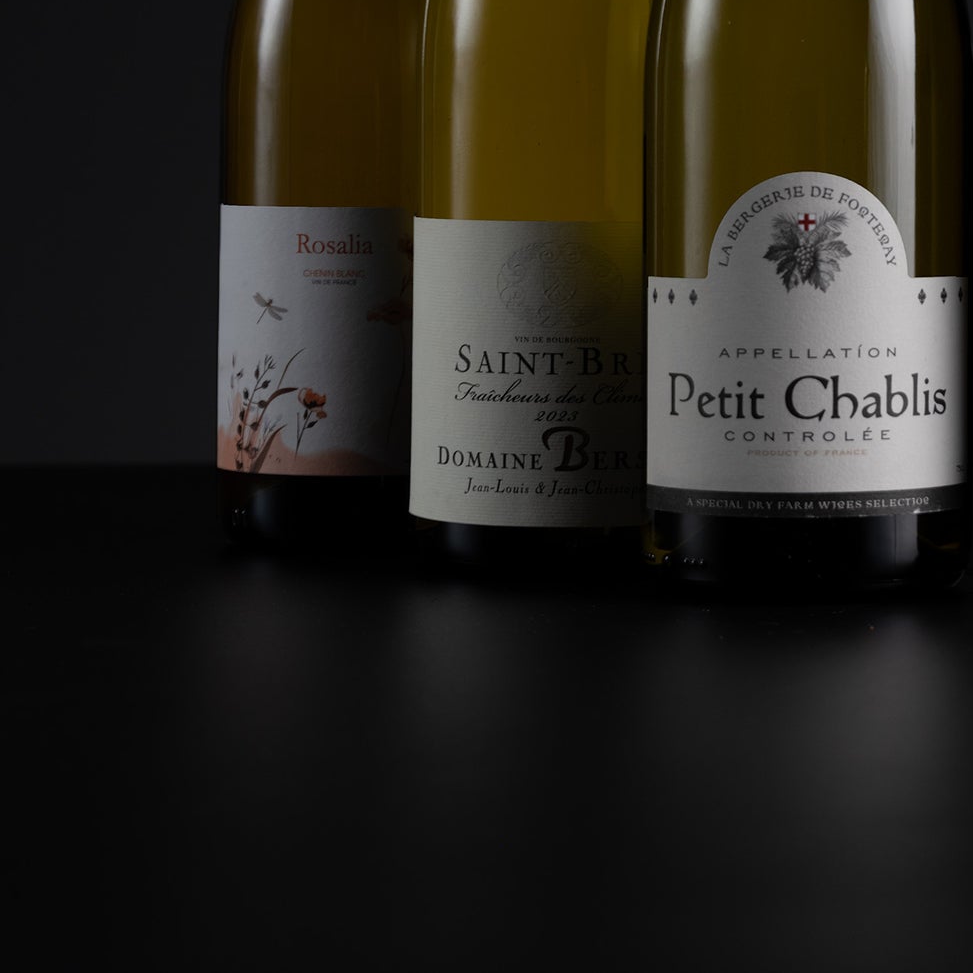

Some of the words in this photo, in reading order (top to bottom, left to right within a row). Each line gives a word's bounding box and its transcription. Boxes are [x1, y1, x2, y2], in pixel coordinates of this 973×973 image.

[718, 245, 734, 268] LA
[810, 185, 835, 200] DE
[295, 233, 374, 255] Rosalia
[514, 335, 531, 344] VIN
[532, 335, 544, 344] DE
[454, 379, 551, 404] Fraîcheurs
[555, 385, 586, 404] des
[668, 372, 765, 420] Petit
[784, 373, 948, 422] Chablis
[533, 410, 580, 423] 2023
[724, 428, 891, 443] CONTROLÉE
[437, 445, 543, 471] DOMAINE
[747, 449, 799, 457] PRODUCT
[803, 449, 821, 457] OF
[824, 448, 868, 457] FRANCE
[464, 477, 529, 495] Jean-Louis
[534, 480, 546, 495] &
[686, 497, 695, 507] A
[747, 500, 773, 511] DRY
[777, 500, 814, 511] FARM
